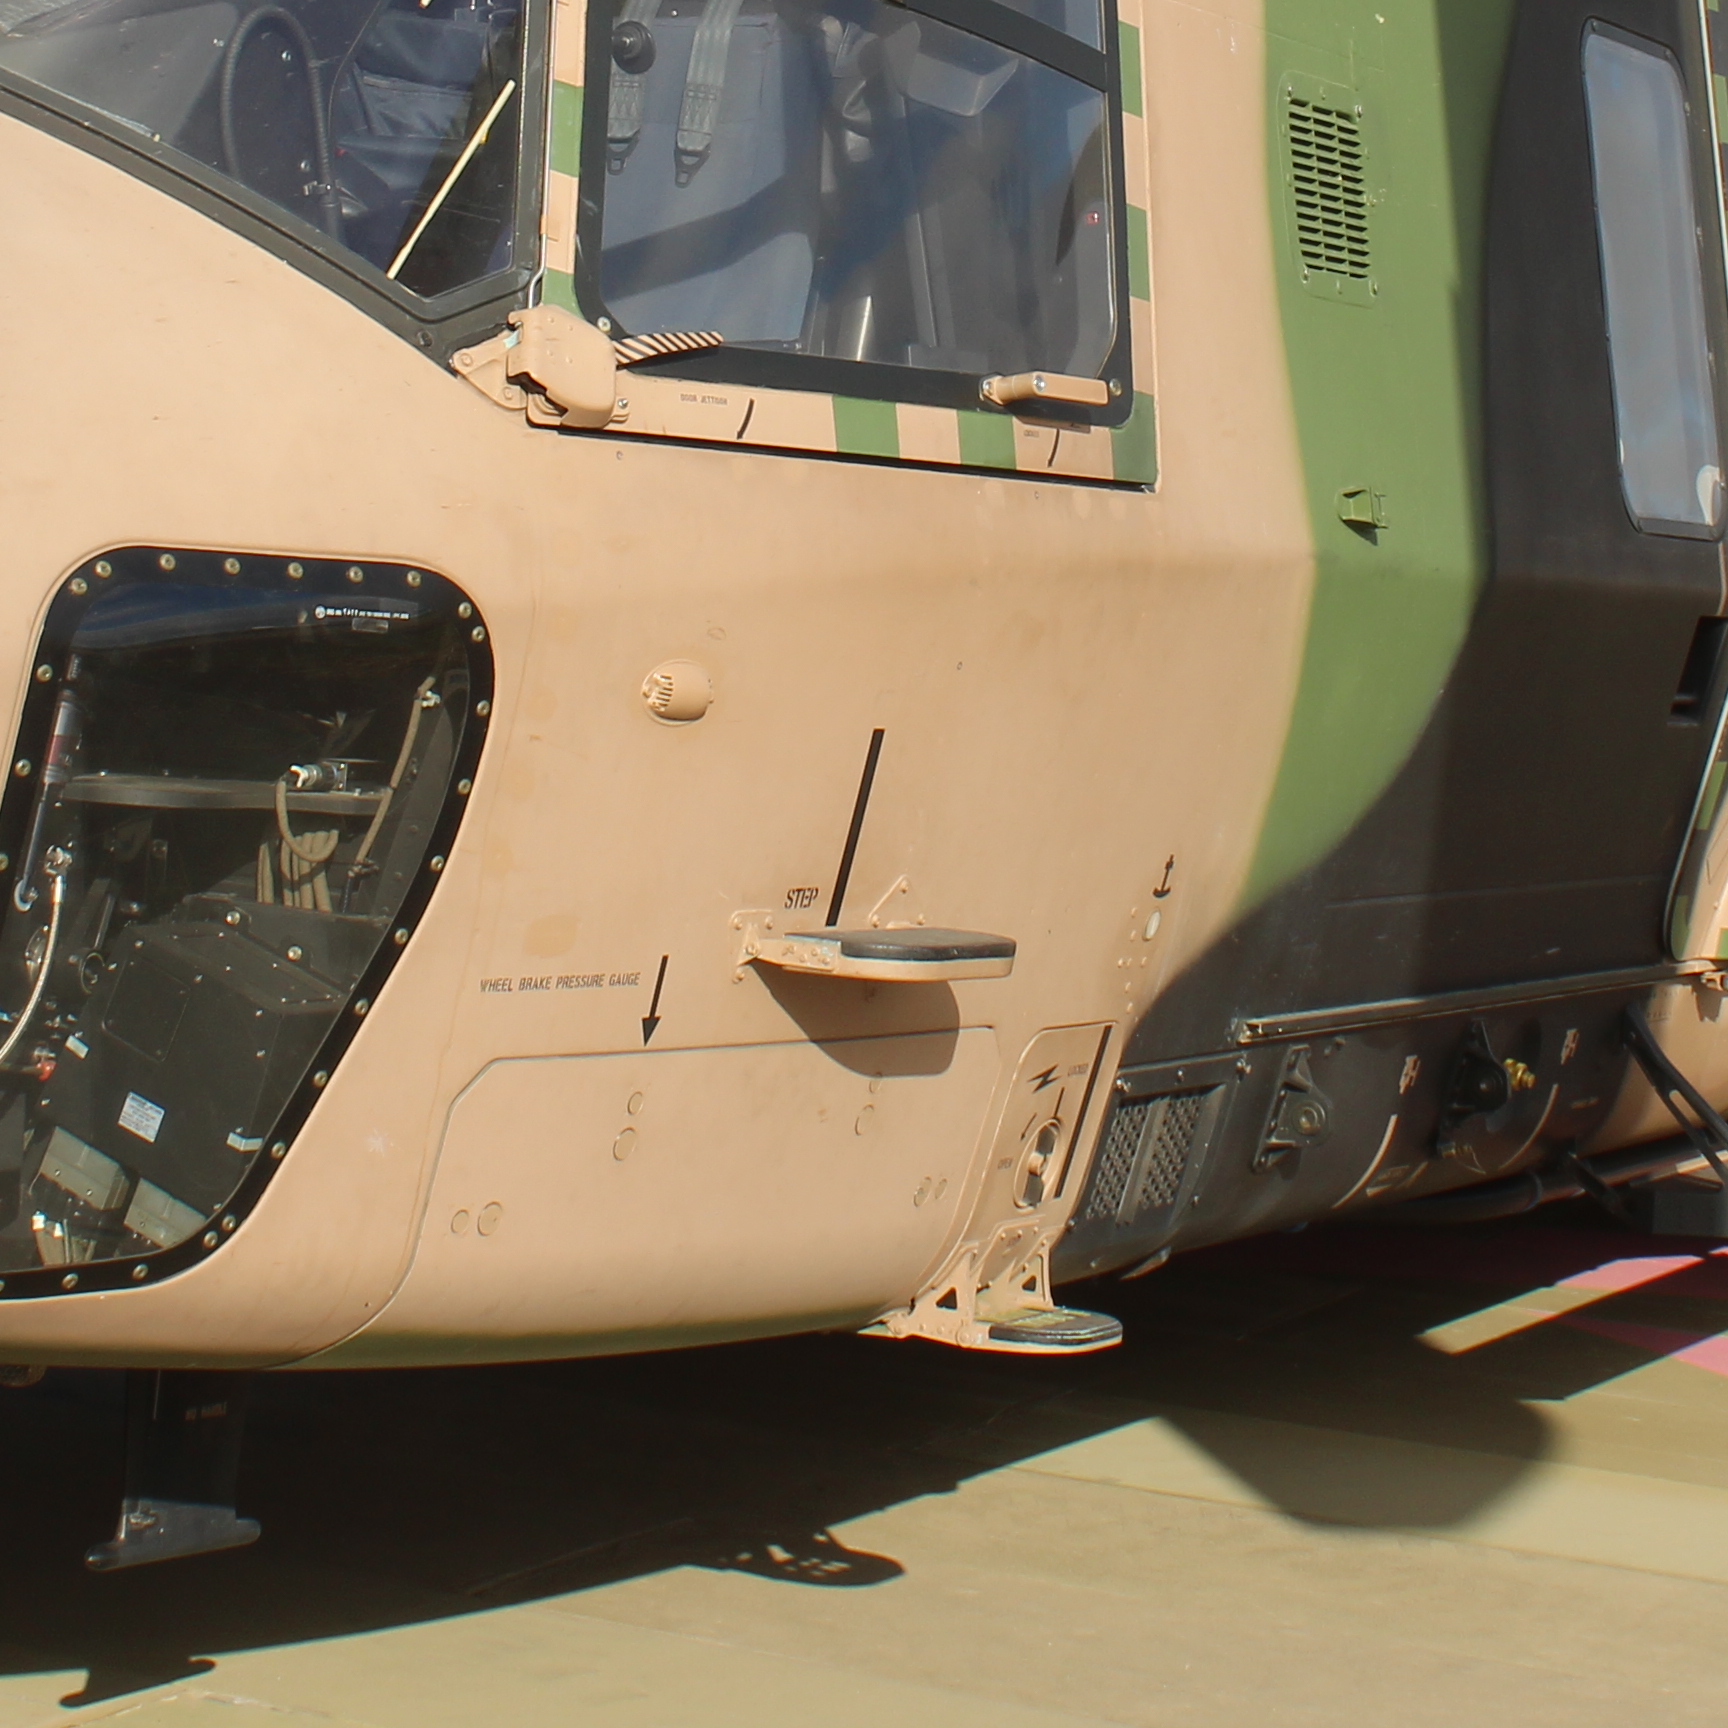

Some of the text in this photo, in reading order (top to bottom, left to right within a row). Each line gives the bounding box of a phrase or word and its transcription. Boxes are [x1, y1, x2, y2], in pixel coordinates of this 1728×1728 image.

[784, 887, 819, 910] STEP
[480, 971, 641, 993] WHEEL BRAKE PRESSURE GAUGE
